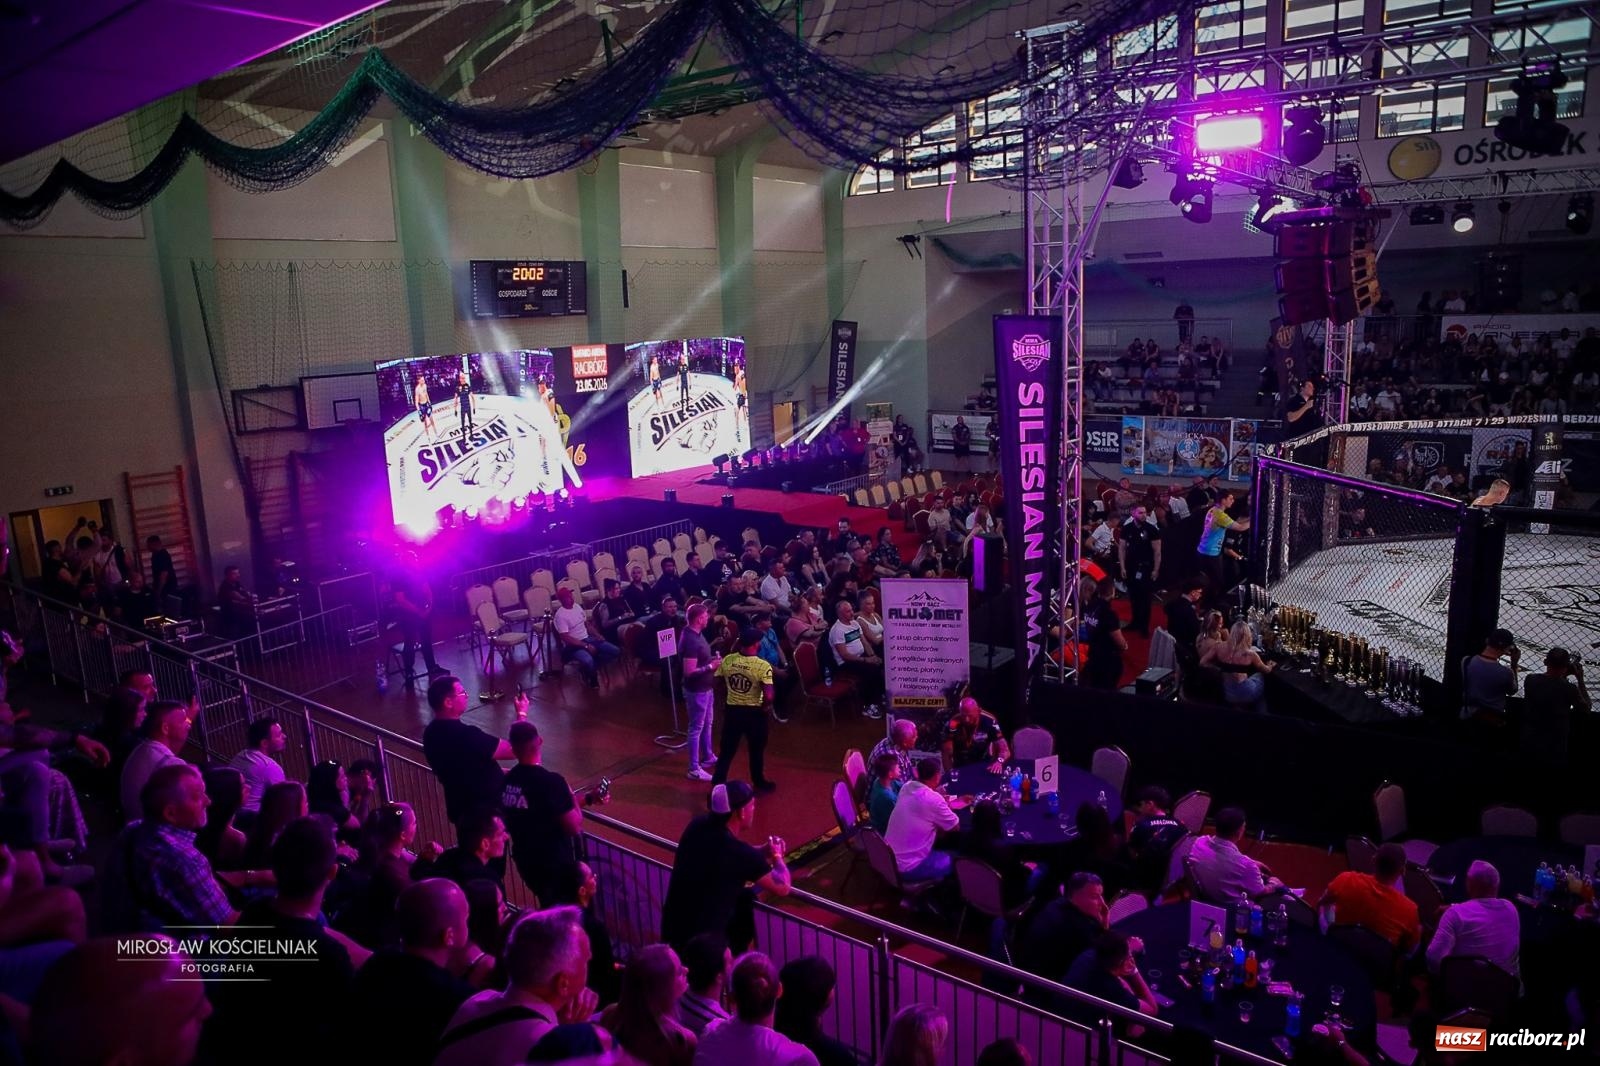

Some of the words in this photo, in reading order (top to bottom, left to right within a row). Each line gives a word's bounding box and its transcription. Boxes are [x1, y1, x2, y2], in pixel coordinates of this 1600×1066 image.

[541, 287, 558, 297] GOŚCIE
[1012, 341, 1051, 359] SILESIAN
[650, 391, 725, 445] SILESIAN
[1407, 419, 1434, 429] MMA
[1436, 418, 1472, 428] ATTACK
[1475, 418, 1482, 426] 7
[1491, 416, 1505, 425] 25
[1507, 414, 1559, 424] WRZEŚNIA
[1018, 382, 1046, 560] SILESIAN
[888, 608, 917, 620] ALU
[933, 608, 964, 621] MET
[1023, 571, 1043, 669] MMA
[660, 633, 673, 642] VIP
[896, 634, 912, 642] skup
[912, 634, 960, 643] akumulatorów
[928, 656, 964, 665] spiekanych
[920, 667, 945, 675] platyny
[919, 676, 946, 684] rzadkich
[903, 683, 939, 692] kolorowych
[894, 698, 927, 706] NAJLEPSZE
[1041, 764, 1053, 783] 6
[1200, 916, 1216, 938] 7
